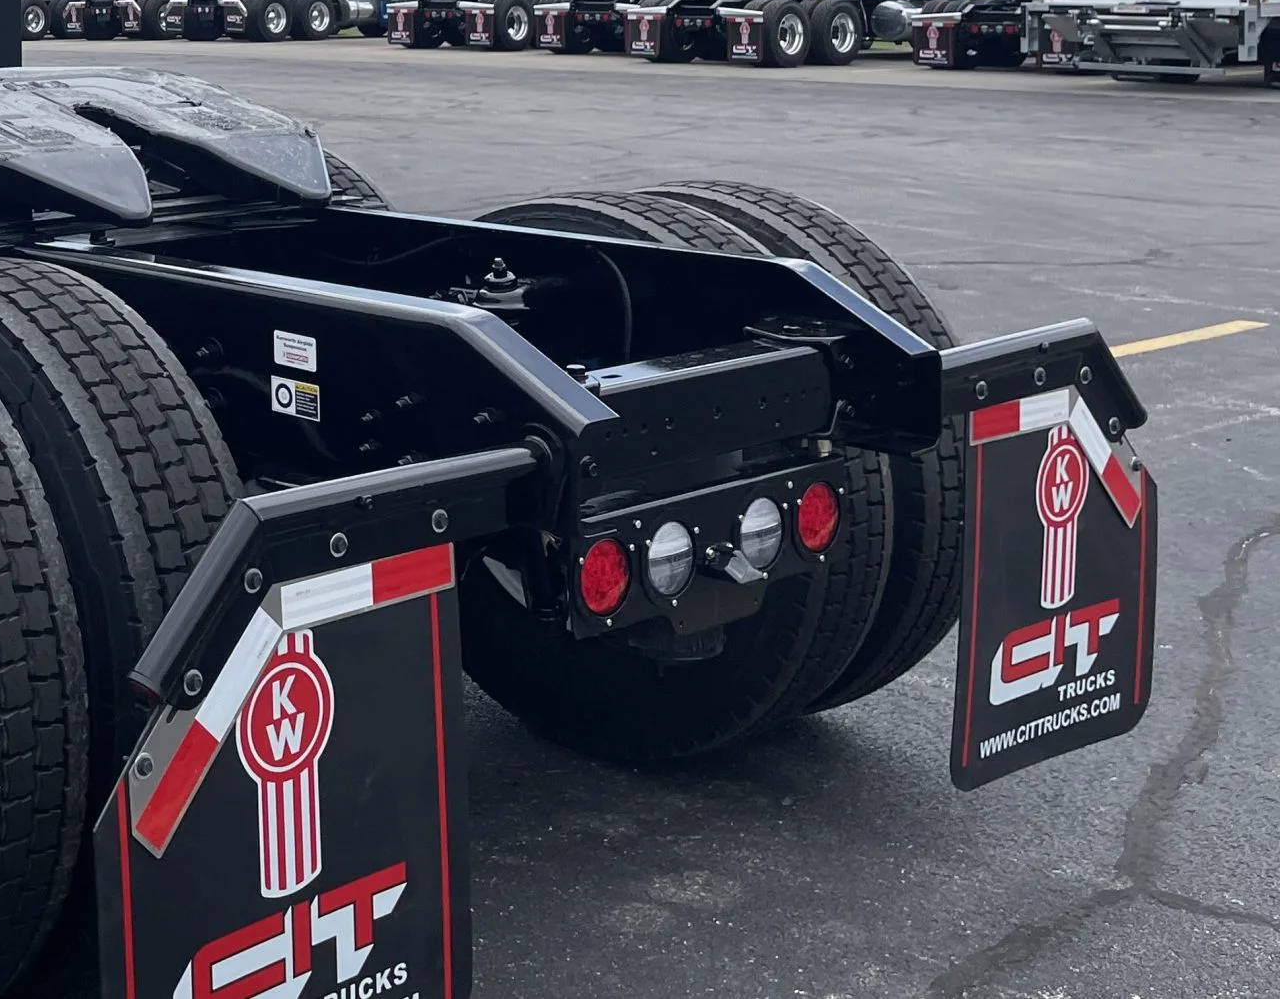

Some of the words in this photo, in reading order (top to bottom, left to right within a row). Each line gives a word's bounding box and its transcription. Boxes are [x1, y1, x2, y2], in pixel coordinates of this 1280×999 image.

[1055, 453, 1071, 485] K
[1051, 480, 1073, 513] W
[989, 598, 1120, 706] CIT
[271, 673, 297, 721] K
[1057, 669, 1116, 701] TRUCKS
[265, 712, 305, 761] W
[979, 692, 1120, 759] WWW.CITTRUCKS.COM
[173, 861, 407, 999] CIT
